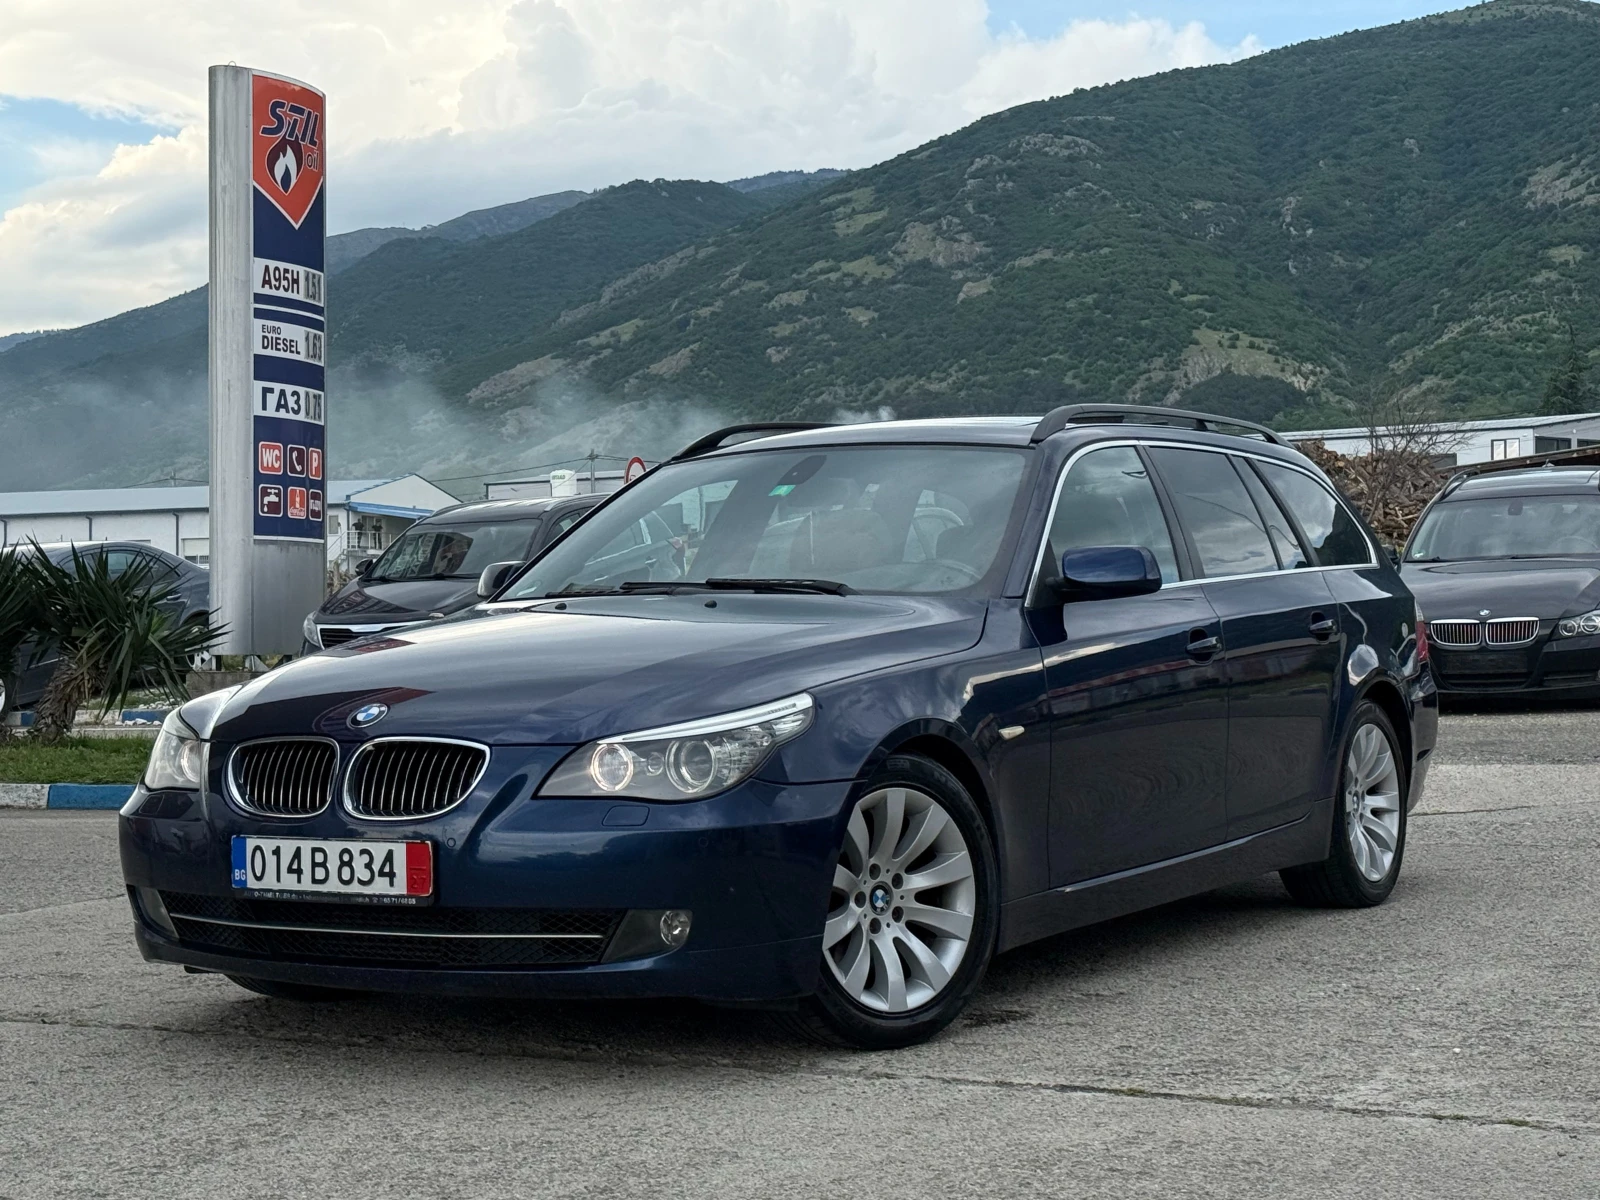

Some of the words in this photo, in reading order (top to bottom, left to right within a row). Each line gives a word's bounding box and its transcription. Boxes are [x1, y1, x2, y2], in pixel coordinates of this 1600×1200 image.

[259, 99, 319, 149] STIL
[306, 150, 319, 172] oil
[261, 264, 300, 295] A95H
[262, 324, 282, 335] EURO
[262, 335, 301, 355] DIESEL
[262, 448, 280, 468] WC
[312, 452, 319, 475] P
[234, 869, 246, 881] BG
